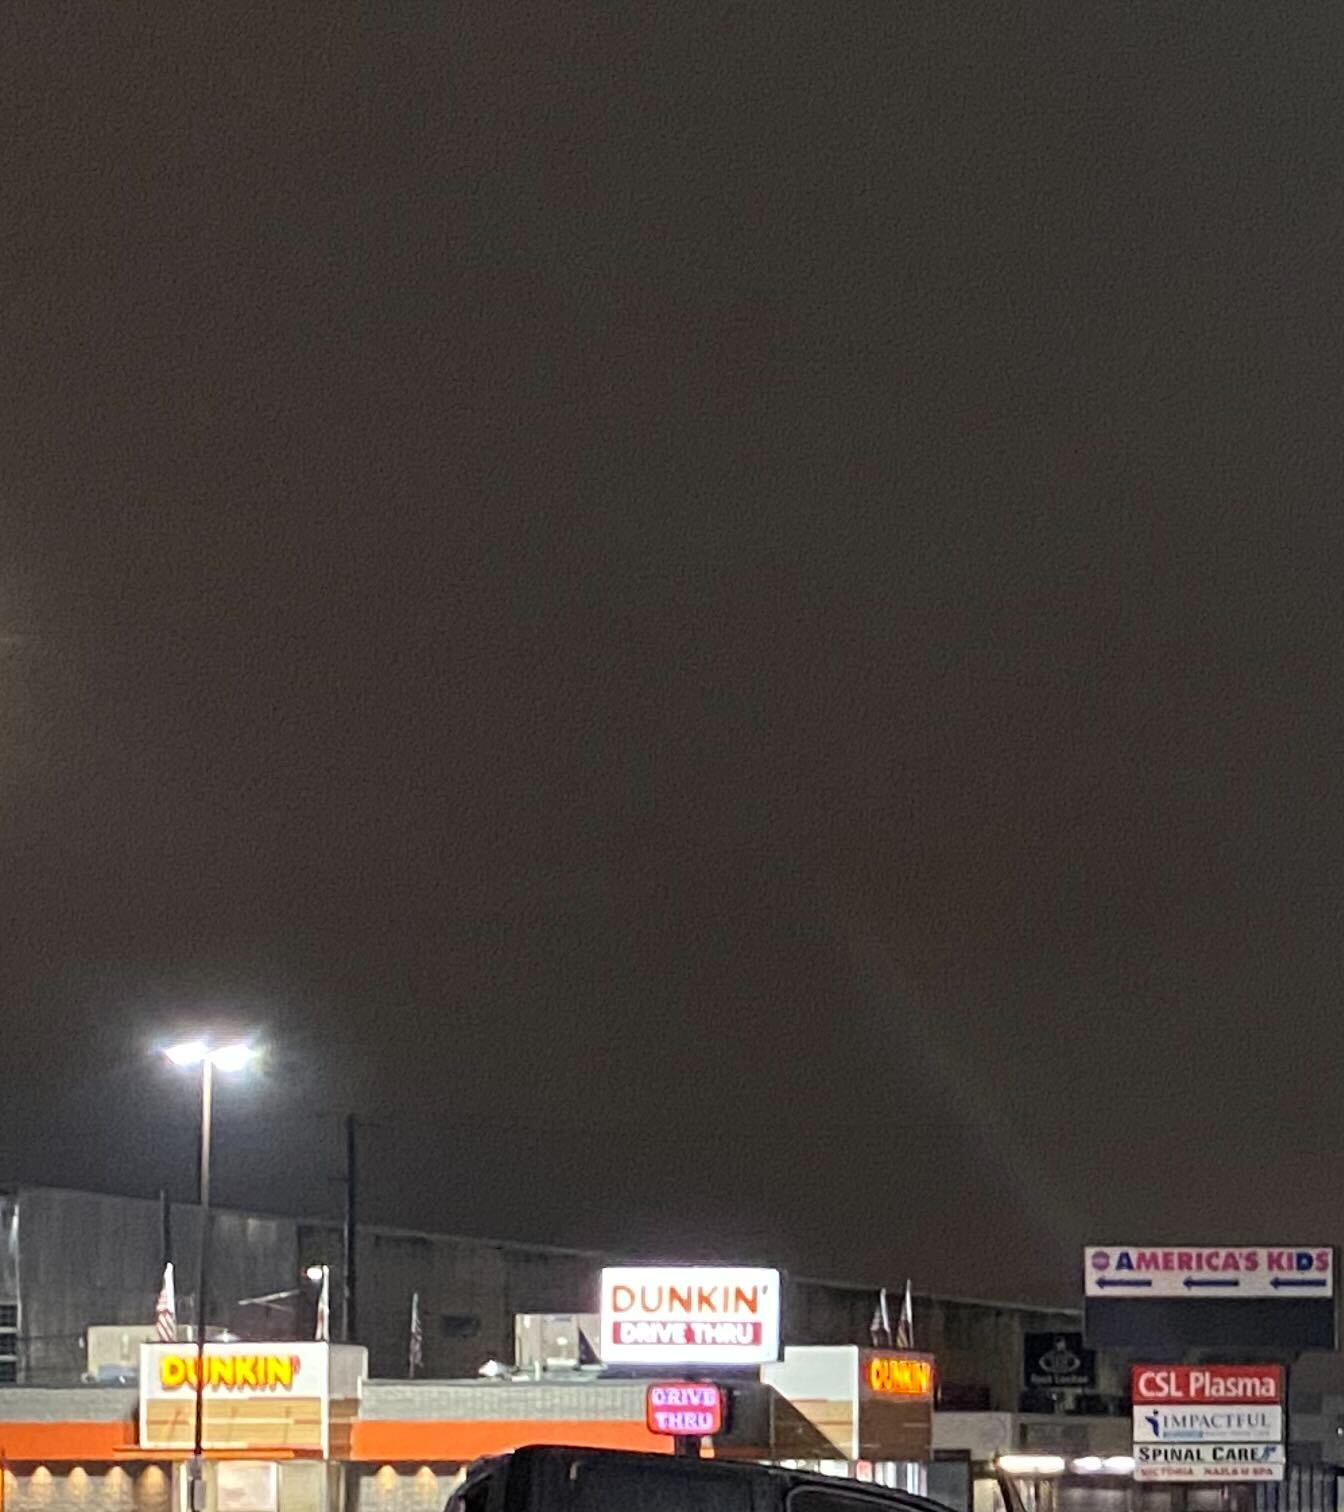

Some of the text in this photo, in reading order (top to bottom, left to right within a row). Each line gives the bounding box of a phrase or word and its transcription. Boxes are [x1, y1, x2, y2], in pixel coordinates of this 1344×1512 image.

[1115, 1251, 1259, 1272] AMERICA'S
[612, 1284, 769, 1314] DUNKIN'
[619, 1321, 754, 1345] DRIVE THRU
[160, 1354, 301, 1390] DUNKIN'
[1137, 1370, 1277, 1399] CSL Plasma
[651, 1386, 717, 1406] DRIVE
[655, 1411, 714, 1431] THRU
[1163, 1412, 1271, 1429] IMPACTFUL
[1138, 1445, 1259, 1463] SPINAL CARE
